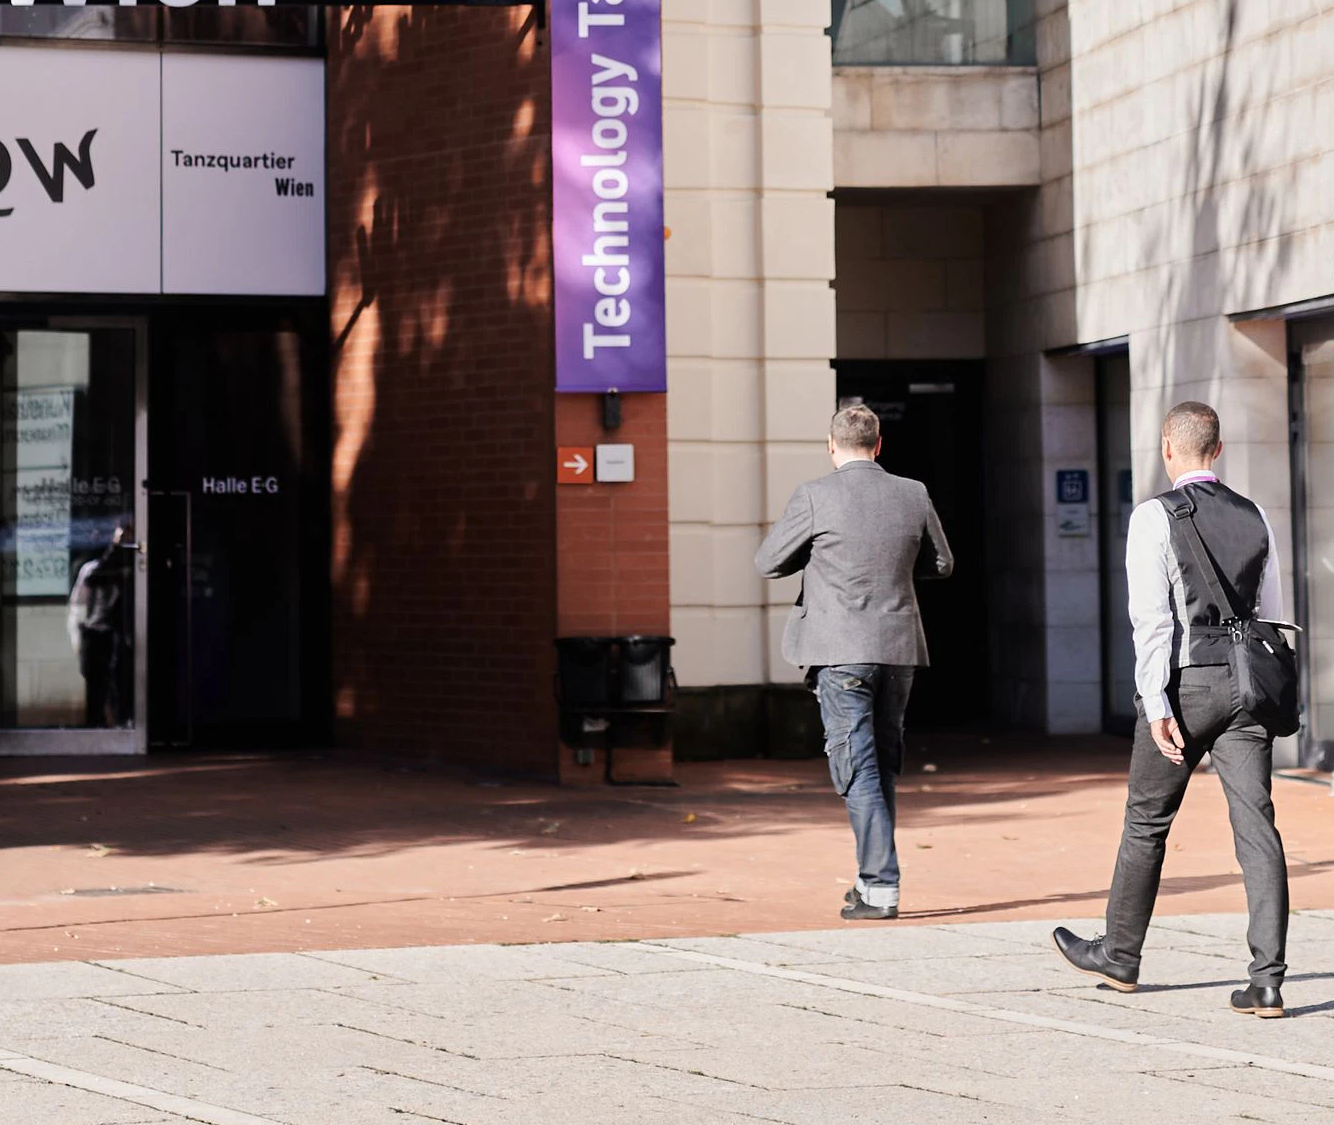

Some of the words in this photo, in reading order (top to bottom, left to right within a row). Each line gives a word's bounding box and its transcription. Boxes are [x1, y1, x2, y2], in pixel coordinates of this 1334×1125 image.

[171, 150, 295, 173] Tanzquartier
[275, 177, 315, 197] Wien
[581, 53, 639, 360] Technology
[202, 477, 247, 493] Halle
